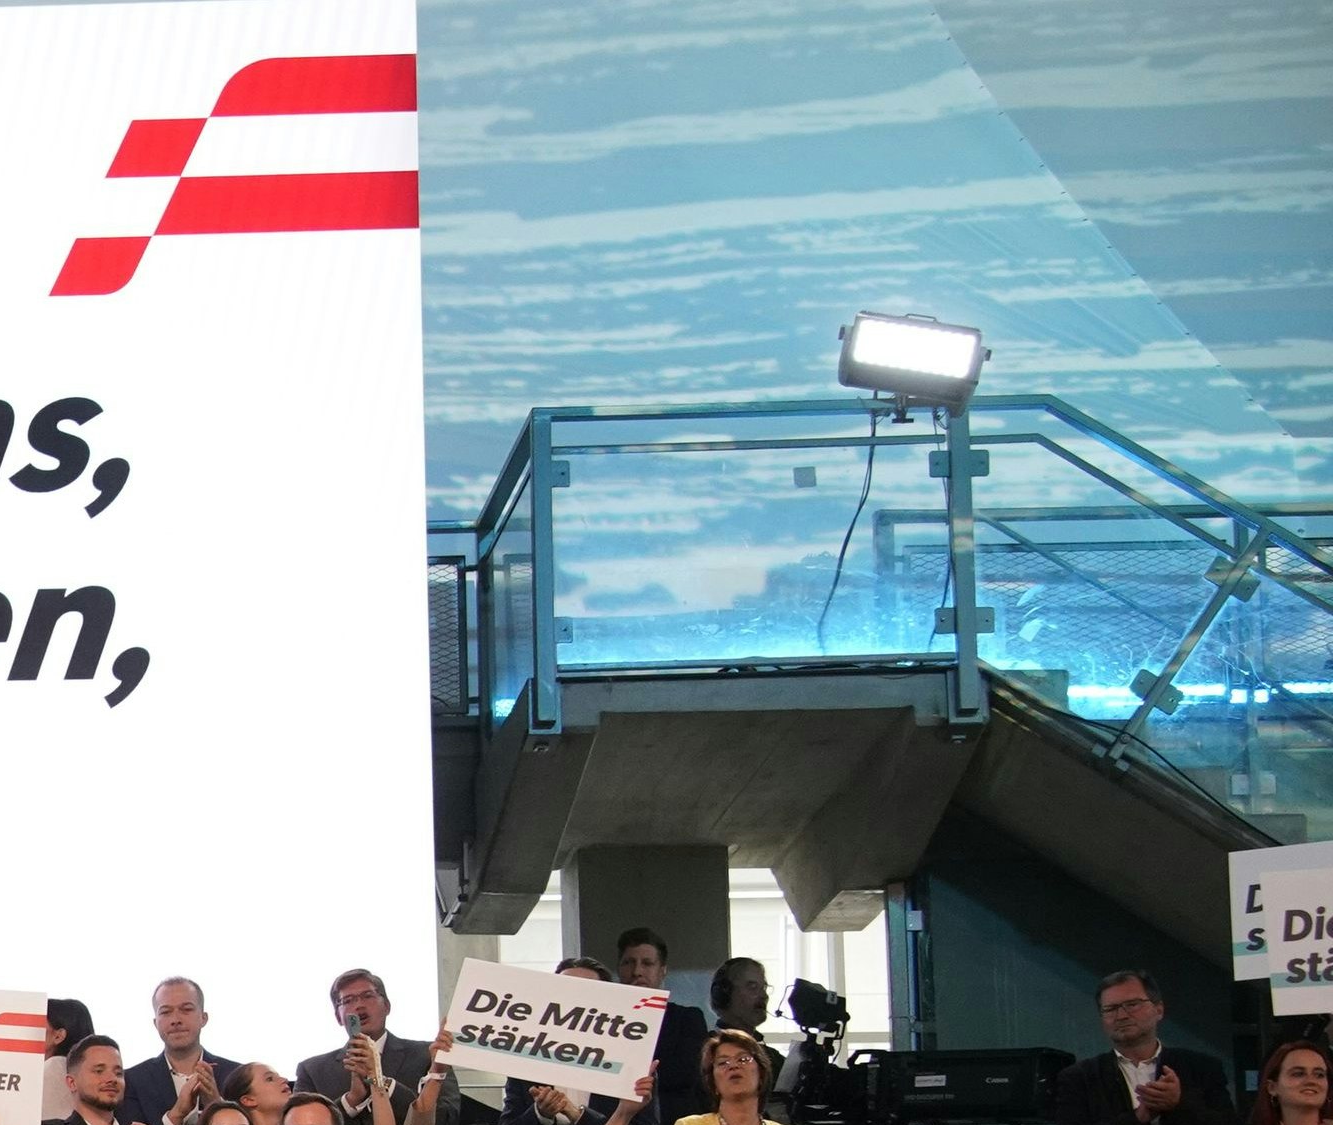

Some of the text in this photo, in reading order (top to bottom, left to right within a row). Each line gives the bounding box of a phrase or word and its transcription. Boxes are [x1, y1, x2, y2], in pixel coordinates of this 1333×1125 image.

[1283, 906, 1333, 942] Di
[465, 988, 649, 1041] Die Mitte
[456, 1024, 613, 1070] stärken.
